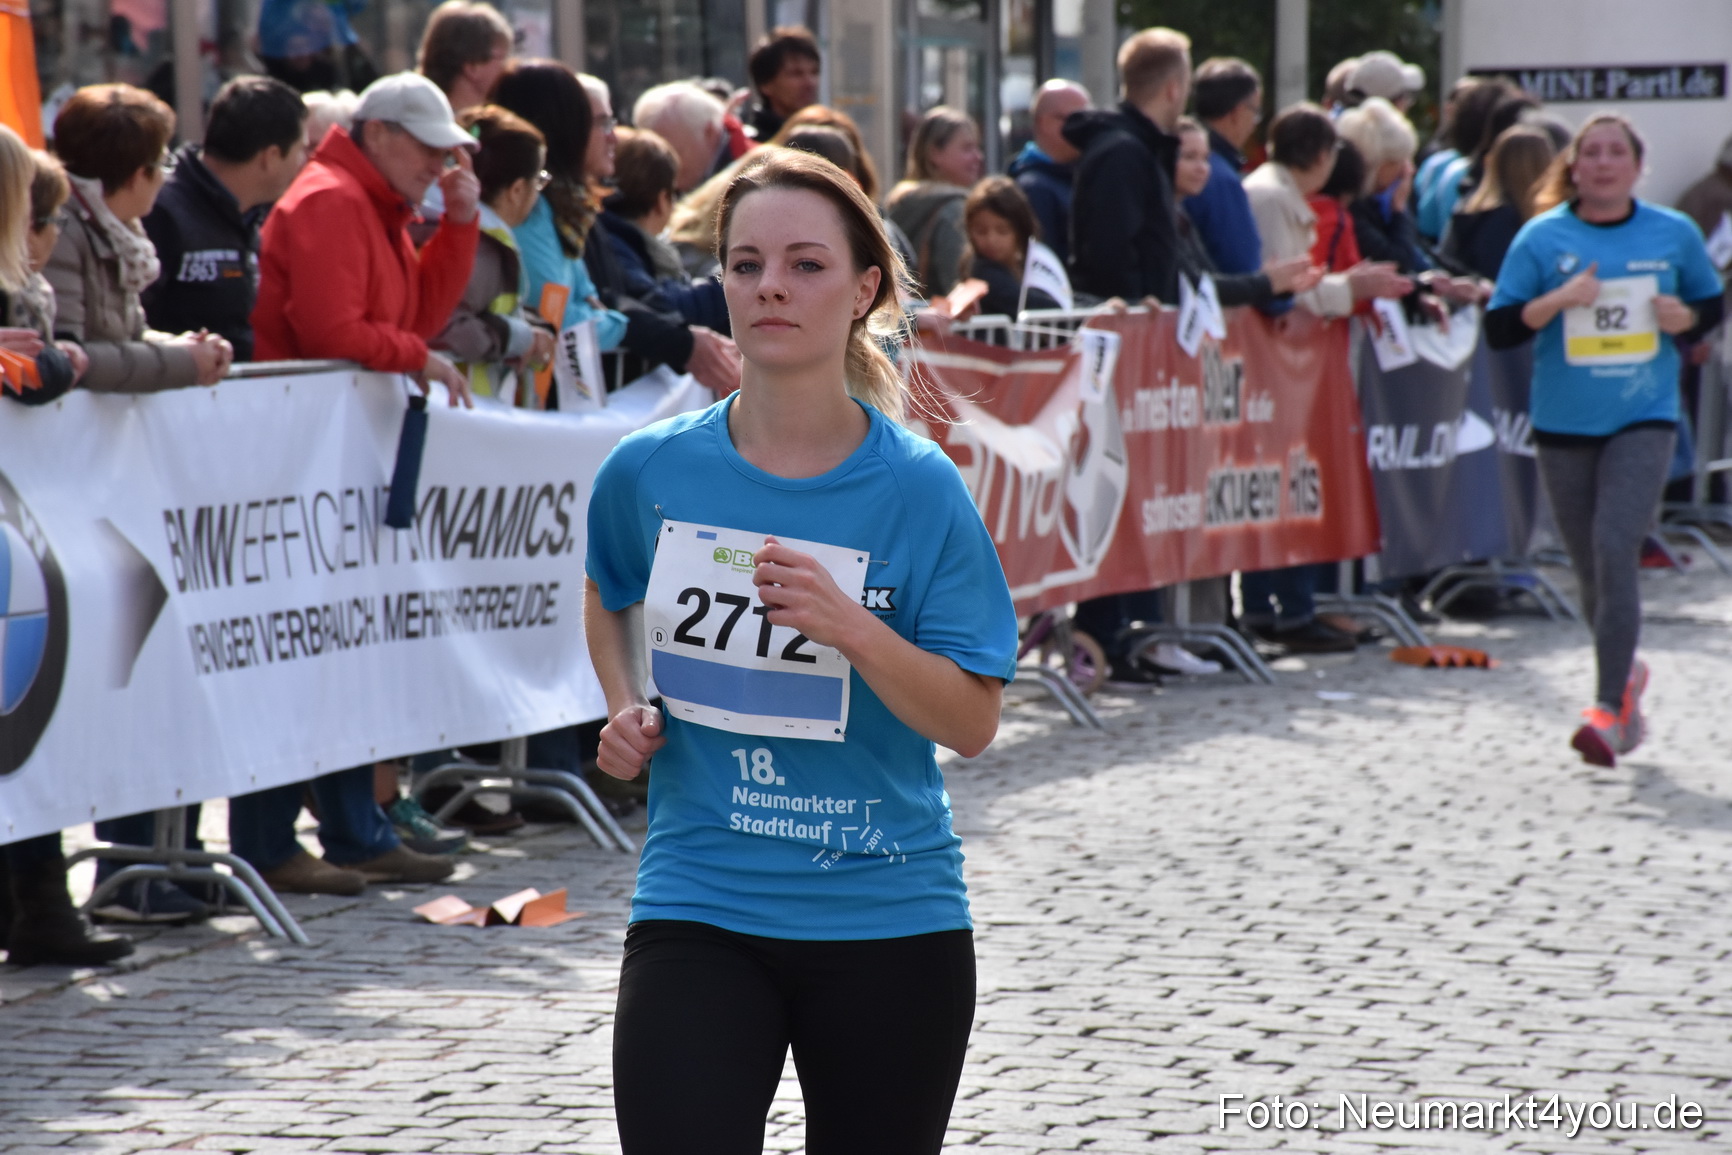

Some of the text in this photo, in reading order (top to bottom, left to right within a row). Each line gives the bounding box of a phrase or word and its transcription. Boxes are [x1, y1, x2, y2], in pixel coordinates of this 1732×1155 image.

[1595, 306, 1628, 331] 82
[656, 631, 663, 643] D
[674, 587, 817, 664] 2712
[731, 747, 785, 786] 18.
[732, 786, 856, 814] Neumarkter
[729, 812, 833, 845] Stadtlauf
[866, 828, 884, 851] 2017
